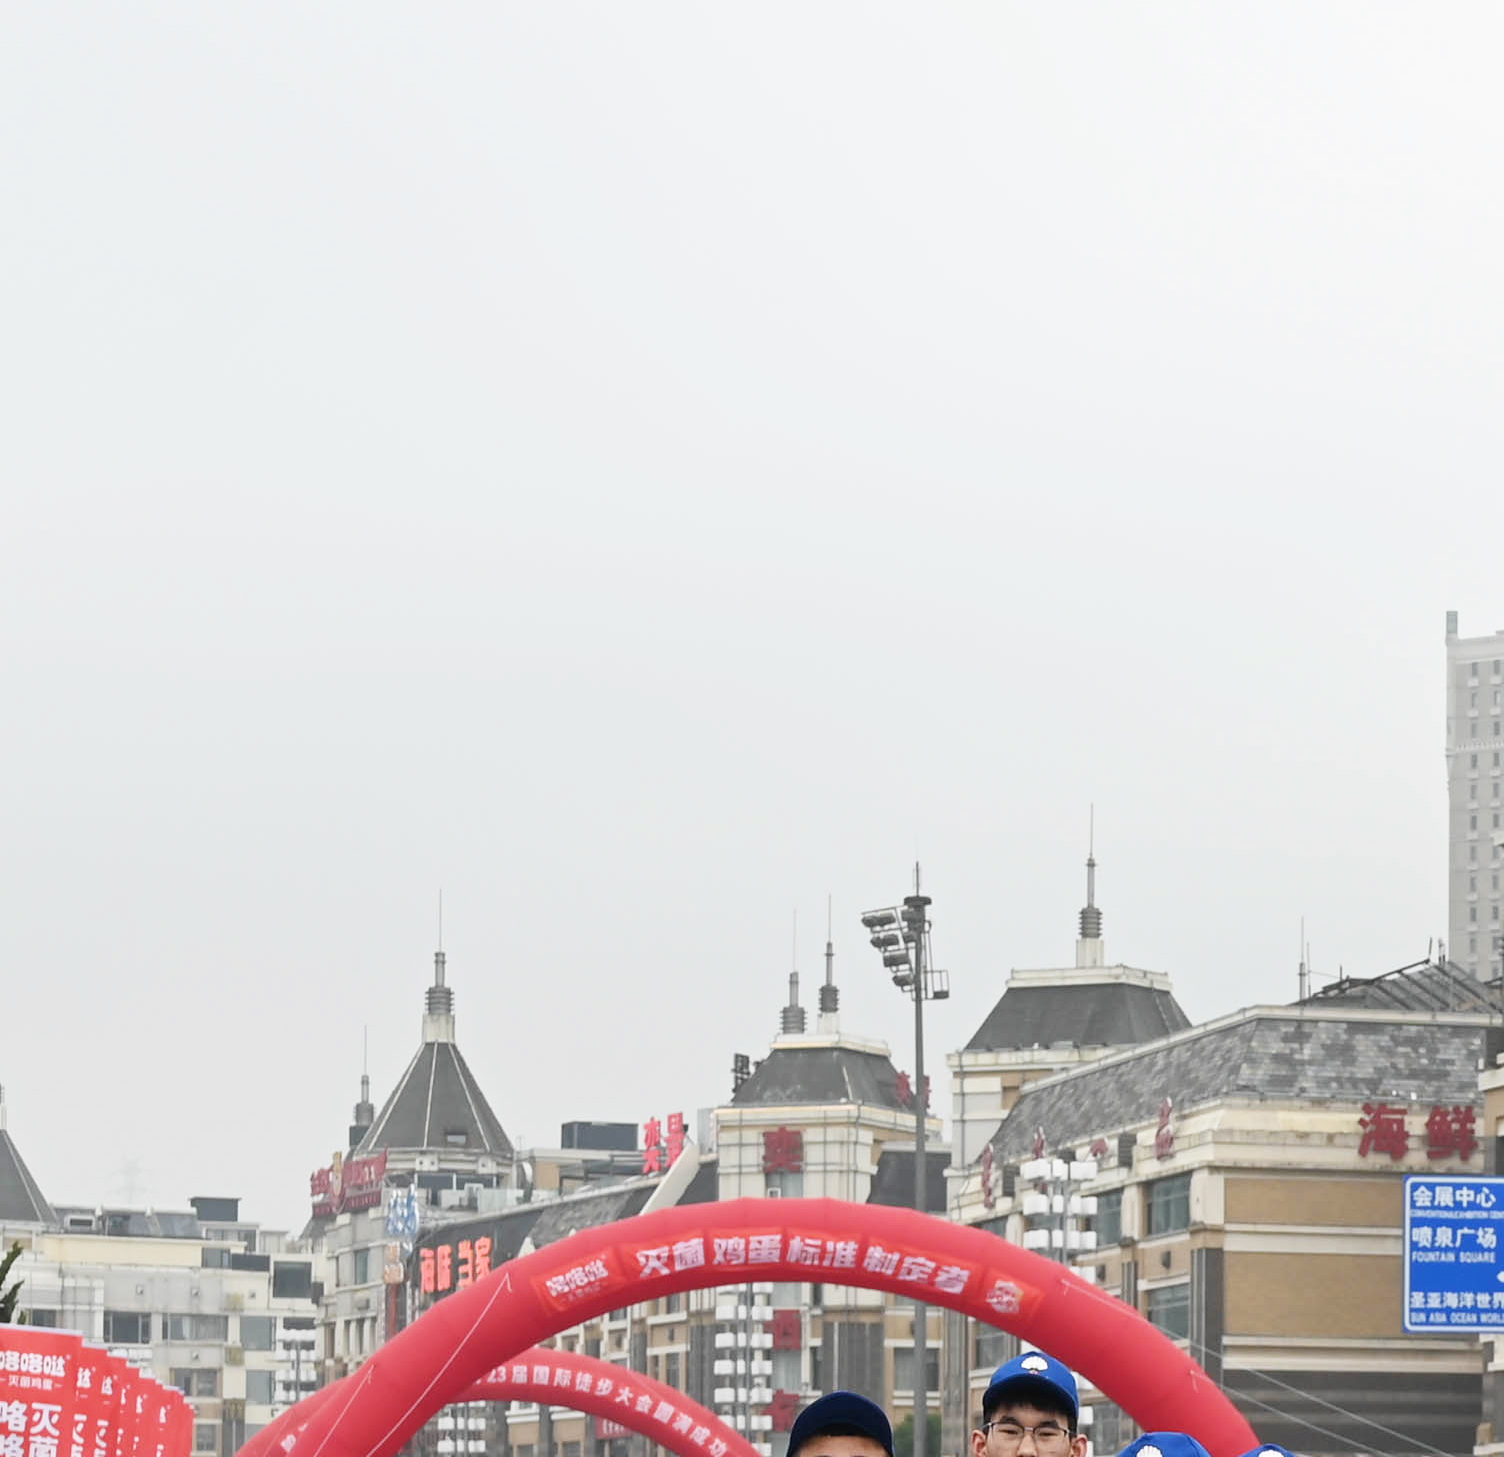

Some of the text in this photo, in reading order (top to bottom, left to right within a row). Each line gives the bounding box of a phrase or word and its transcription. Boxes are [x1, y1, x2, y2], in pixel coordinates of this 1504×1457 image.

[1358, 1103, 1478, 1161] 海鲜
[1413, 1186, 1496, 1208] 会展中心
[1412, 1227, 1496, 1248] 喷泉广场
[1412, 1252, 1495, 1263] FOUNTAIN SQUARE
